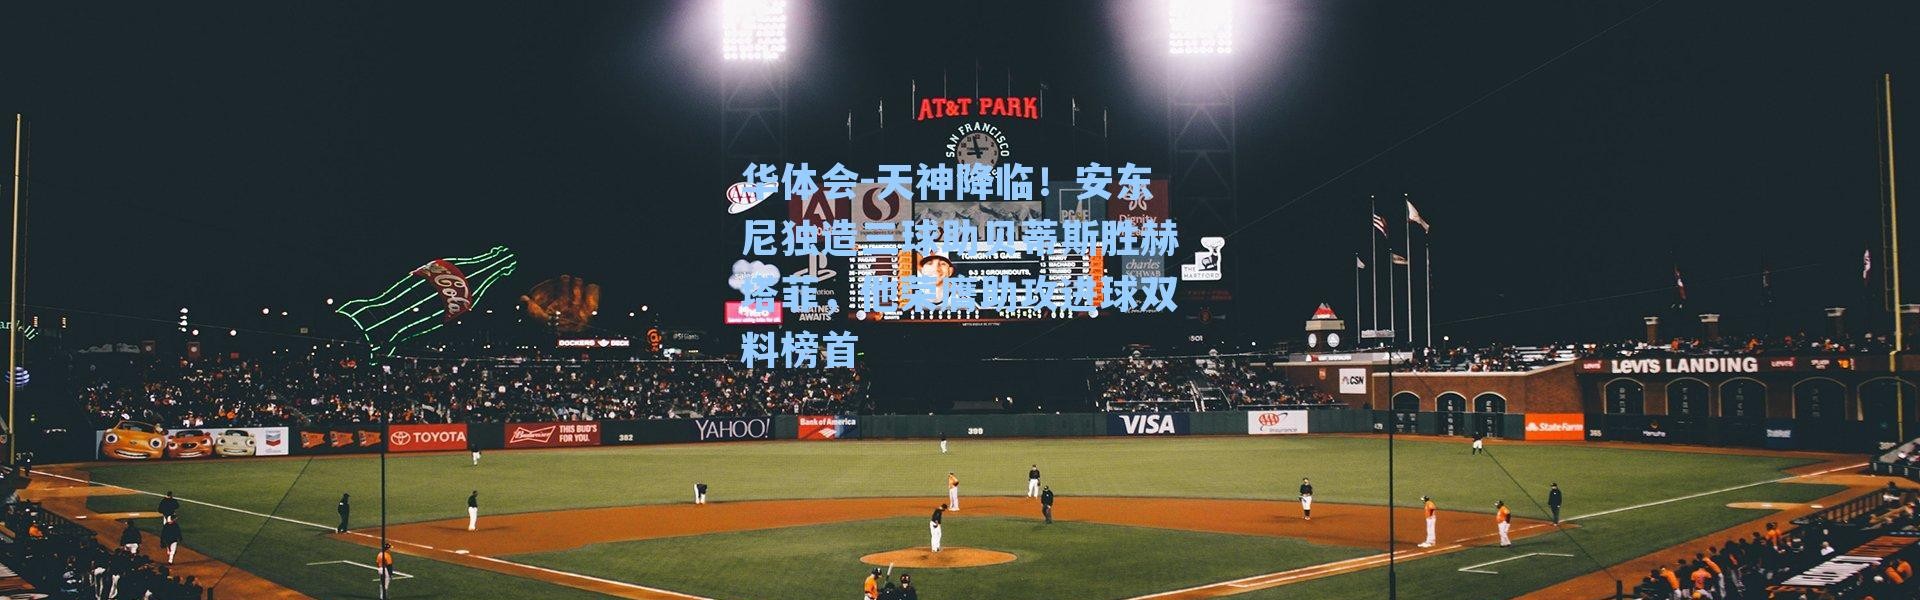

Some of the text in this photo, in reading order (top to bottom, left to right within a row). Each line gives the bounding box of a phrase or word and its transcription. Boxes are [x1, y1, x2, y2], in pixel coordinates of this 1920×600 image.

[918, 97, 1038, 121] AT&T PARK
[946, 121, 1010, 158] SAN FRANCISCO
[1125, 259, 1160, 270] charles
[799, 313, 832, 321] AWAITS
[558, 339, 596, 347] DOCKERS
[1665, 358, 1759, 373] LANDING
[1350, 377, 1364, 385] CSN
[800, 418, 856, 426] Bank of America
[1118, 414, 1176, 435] VISA
[560, 424, 598, 433] THIS BUD'S
[695, 418, 771, 441] YAHOO!
[413, 431, 467, 443] TOYOTA
[560, 433, 573, 442] FOR
